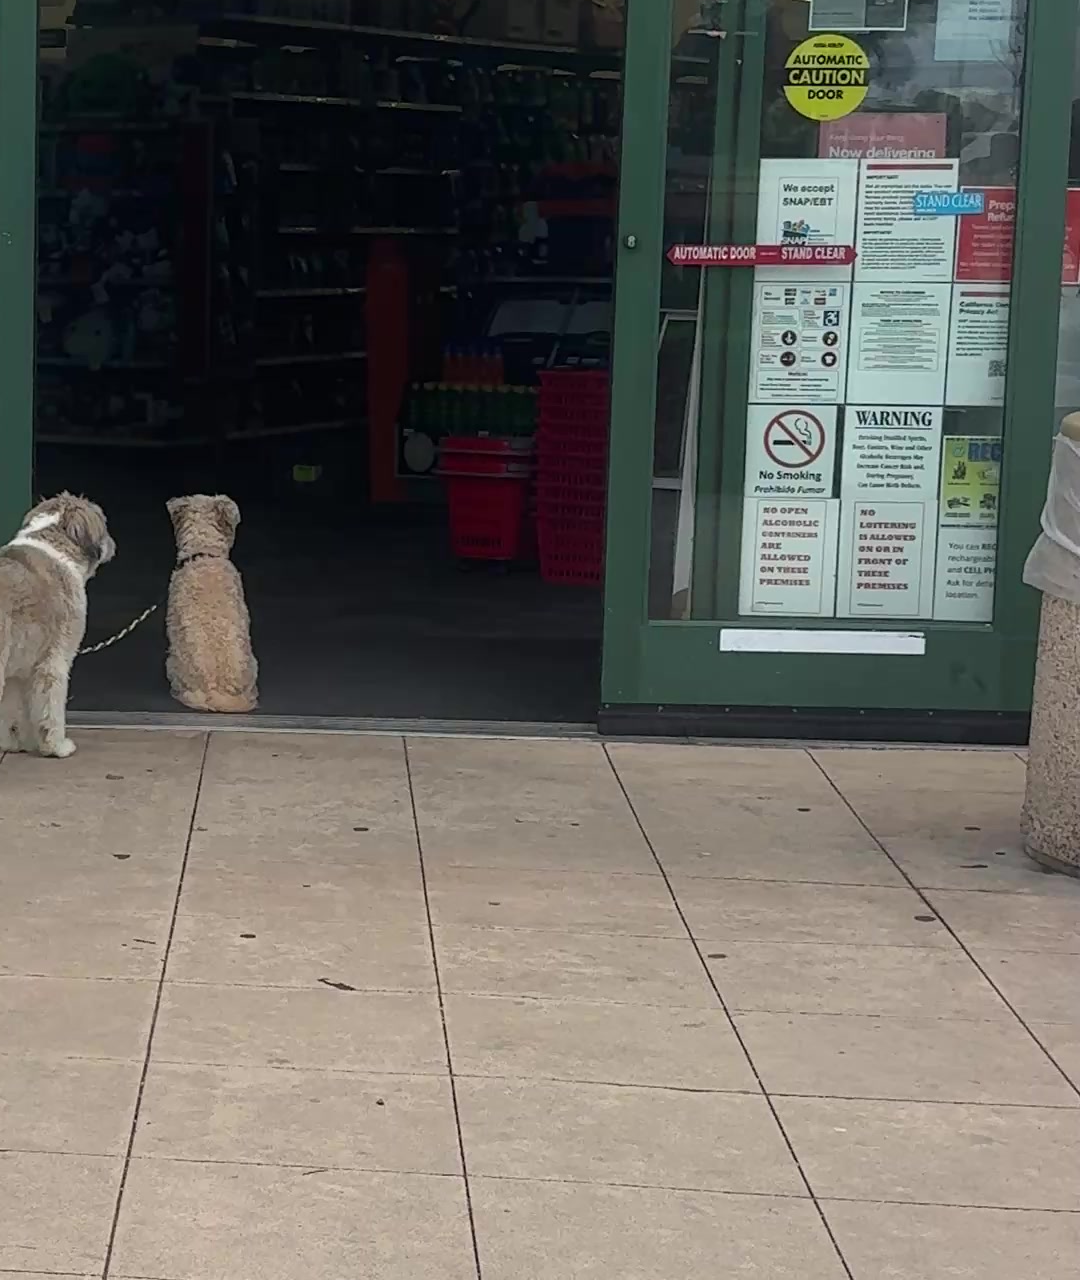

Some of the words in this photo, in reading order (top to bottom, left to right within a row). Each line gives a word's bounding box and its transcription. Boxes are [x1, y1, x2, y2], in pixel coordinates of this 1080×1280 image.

[793, 55, 862, 64] AUTOMATIC
[788, 70, 864, 84] CAUTION
[808, 90, 844, 100] DOOR
[829, 146, 862, 158] Now
[866, 146, 936, 158] delivering
[782, 184, 798, 192] We
[800, 184, 834, 193] accept
[782, 198, 834, 206] SNAP/EBT
[916, 194, 950, 208] STAND
[951, 195, 982, 208] CLEAR
[988, 200, 1015, 210] Prep
[674, 247, 728, 260] AUTOMATIC
[730, 248, 756, 260] DOOR
[782, 247, 813, 260] STAND
[815, 248, 846, 260] CLEAR
[856, 410, 932, 426] WARNING
[759, 470, 774, 480] No
[776, 470, 822, 482] Smoking
[754, 486, 796, 494] Prohibido
[762, 519, 819, 528] ALCOHOLIC
[859, 522, 916, 530] LOITERING
[762, 531, 818, 539] CONTAINERS
[869, 534, 916, 542] ALLOWED
[760, 542, 782, 550] ARE
[948, 543, 964, 551] You
[981, 543, 997, 551] REC
[760, 554, 812, 562] ALLOWED
[857, 558, 892, 566] FRONT
[894, 558, 909, 566] OF
[760, 566, 774, 574] ON
[776, 566, 808, 574] THESE
[857, 570, 890, 578] THESE
[947, 566, 962, 574] and
[964, 566, 982, 574] CELL
[759, 578, 810, 586] PREMISES
[856, 582, 909, 590] PREMISES
